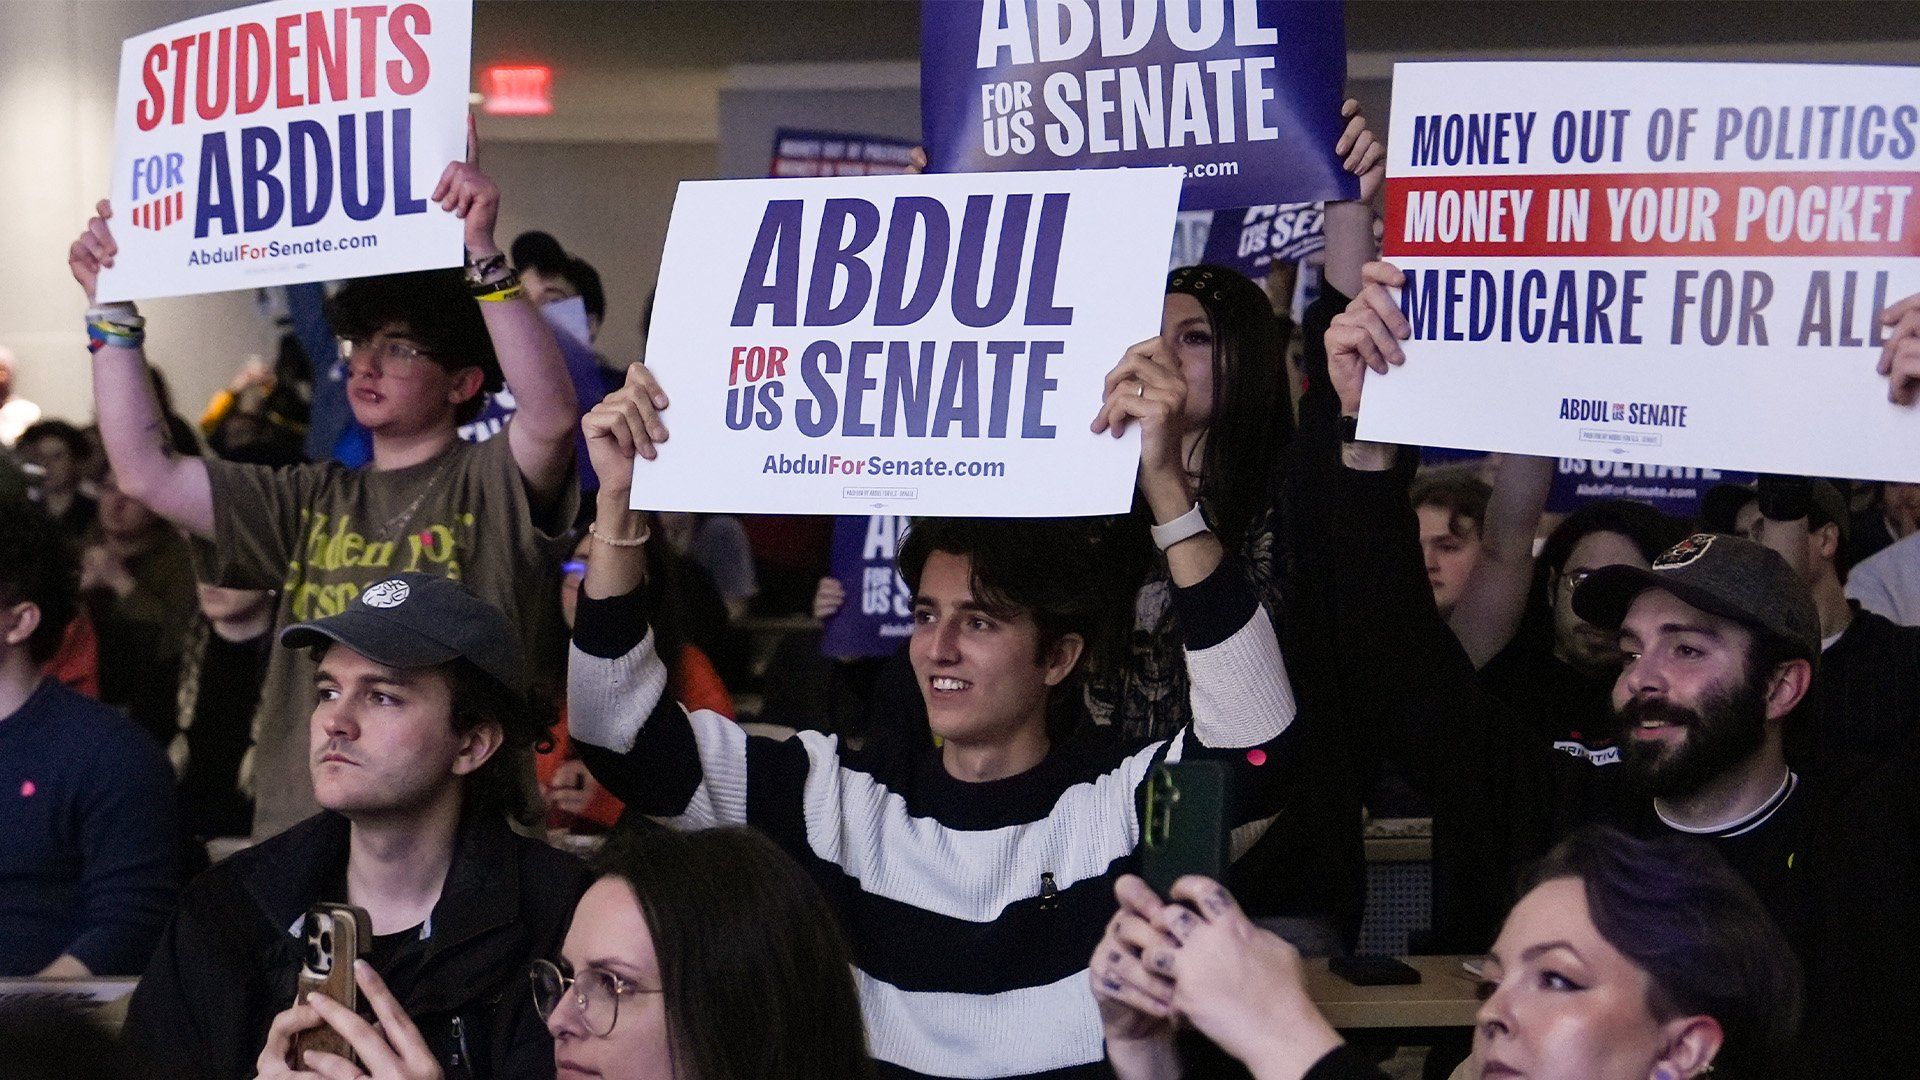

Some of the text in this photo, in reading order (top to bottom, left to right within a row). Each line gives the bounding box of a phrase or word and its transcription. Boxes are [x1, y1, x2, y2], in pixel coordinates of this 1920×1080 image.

[136, 3, 432, 132] STUDENTS
[982, 81, 1033, 120] FOR
[1043, 56, 1278, 157] SENATE
[983, 110, 1036, 157] US
[1411, 104, 1919, 167] MONEY OUT OF POLITICS
[132, 152, 184, 201] FOR
[194, 107, 427, 239] ABDUL
[1403, 185, 1913, 243] MONEY IN YOUR POCKET
[188, 234, 378, 266] AbdulForSenate.com
[730, 193, 1074, 327] ABDUL
[1402, 268, 1892, 347] MEDICARE FOR ALL
[729, 346, 788, 386] FOR
[795, 340, 1065, 439] SENATE
[726, 382, 784, 432] US
[1559, 398, 1609, 422] ABDUL
[1628, 402, 1688, 428] SENATE
[763, 454, 1005, 477] AbdulForSenate.com
